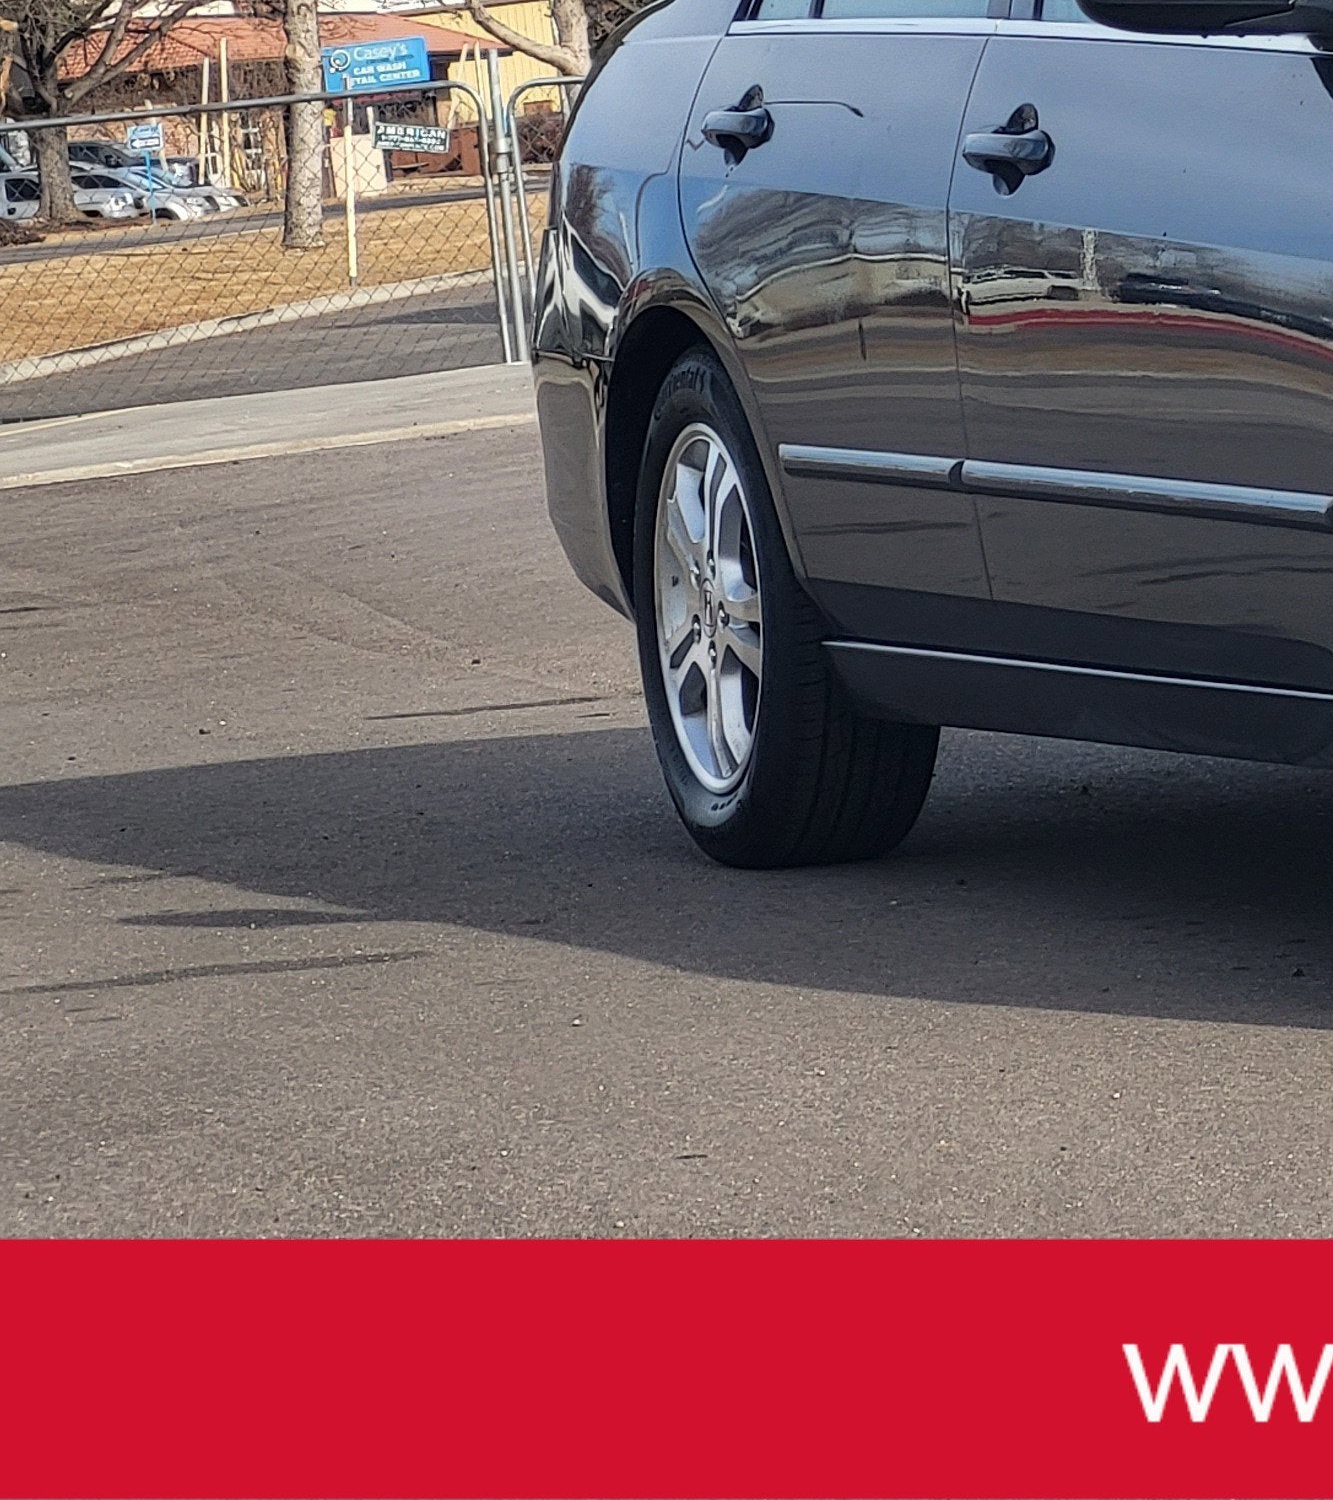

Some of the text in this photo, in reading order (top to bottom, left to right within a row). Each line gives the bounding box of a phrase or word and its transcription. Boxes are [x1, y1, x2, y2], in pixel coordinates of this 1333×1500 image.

[354, 43, 408, 61] Casey's
[353, 61, 407, 76] CAR WASH
[379, 69, 421, 82] CENTER
[377, 125, 446, 139] AMERICAN
